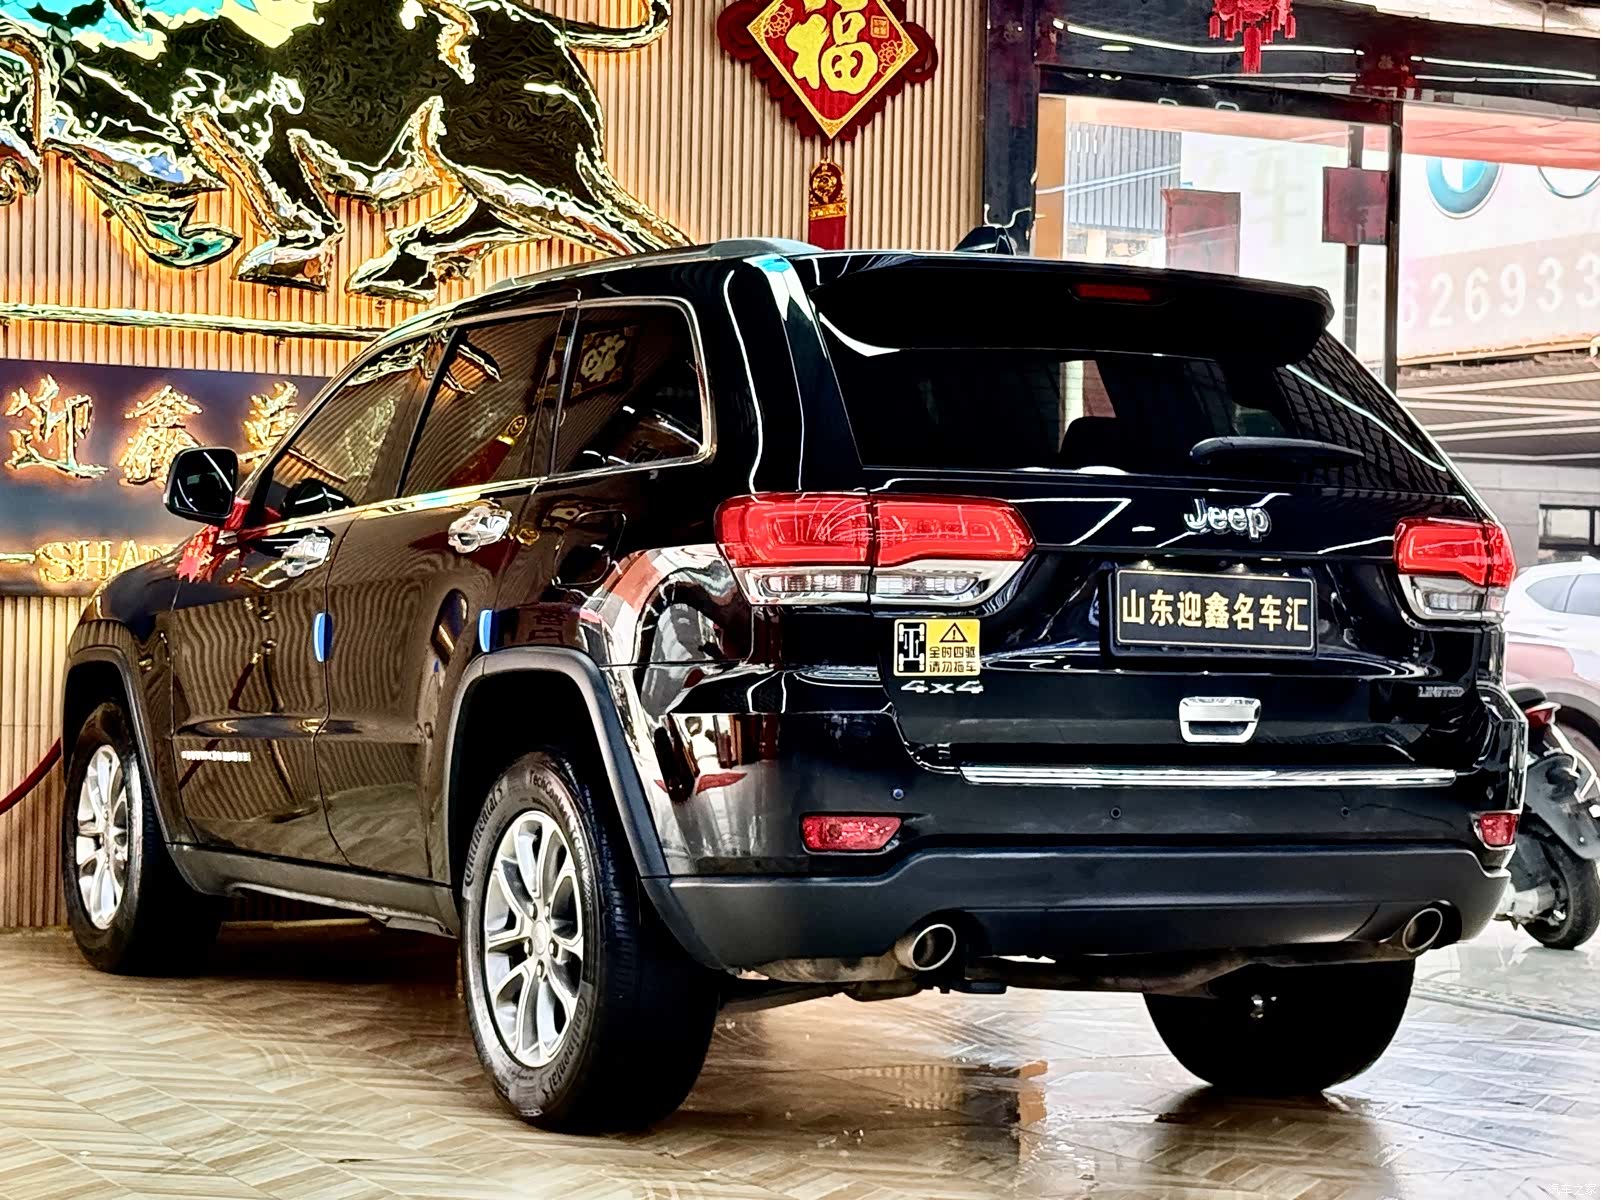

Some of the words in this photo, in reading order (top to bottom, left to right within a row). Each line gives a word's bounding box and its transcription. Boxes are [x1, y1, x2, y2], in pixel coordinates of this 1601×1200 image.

[785, 0, 878, 94] 福
[1184, 498, 1271, 542] Jeep
[1122, 588, 1309, 632] 山东迎鑫名车汇
[929, 646, 976, 659] 全时四驱
[929, 661, 977, 673] 请勿拖车
[464, 798, 499, 888] Continental
[547, 996, 588, 1093] Continental
